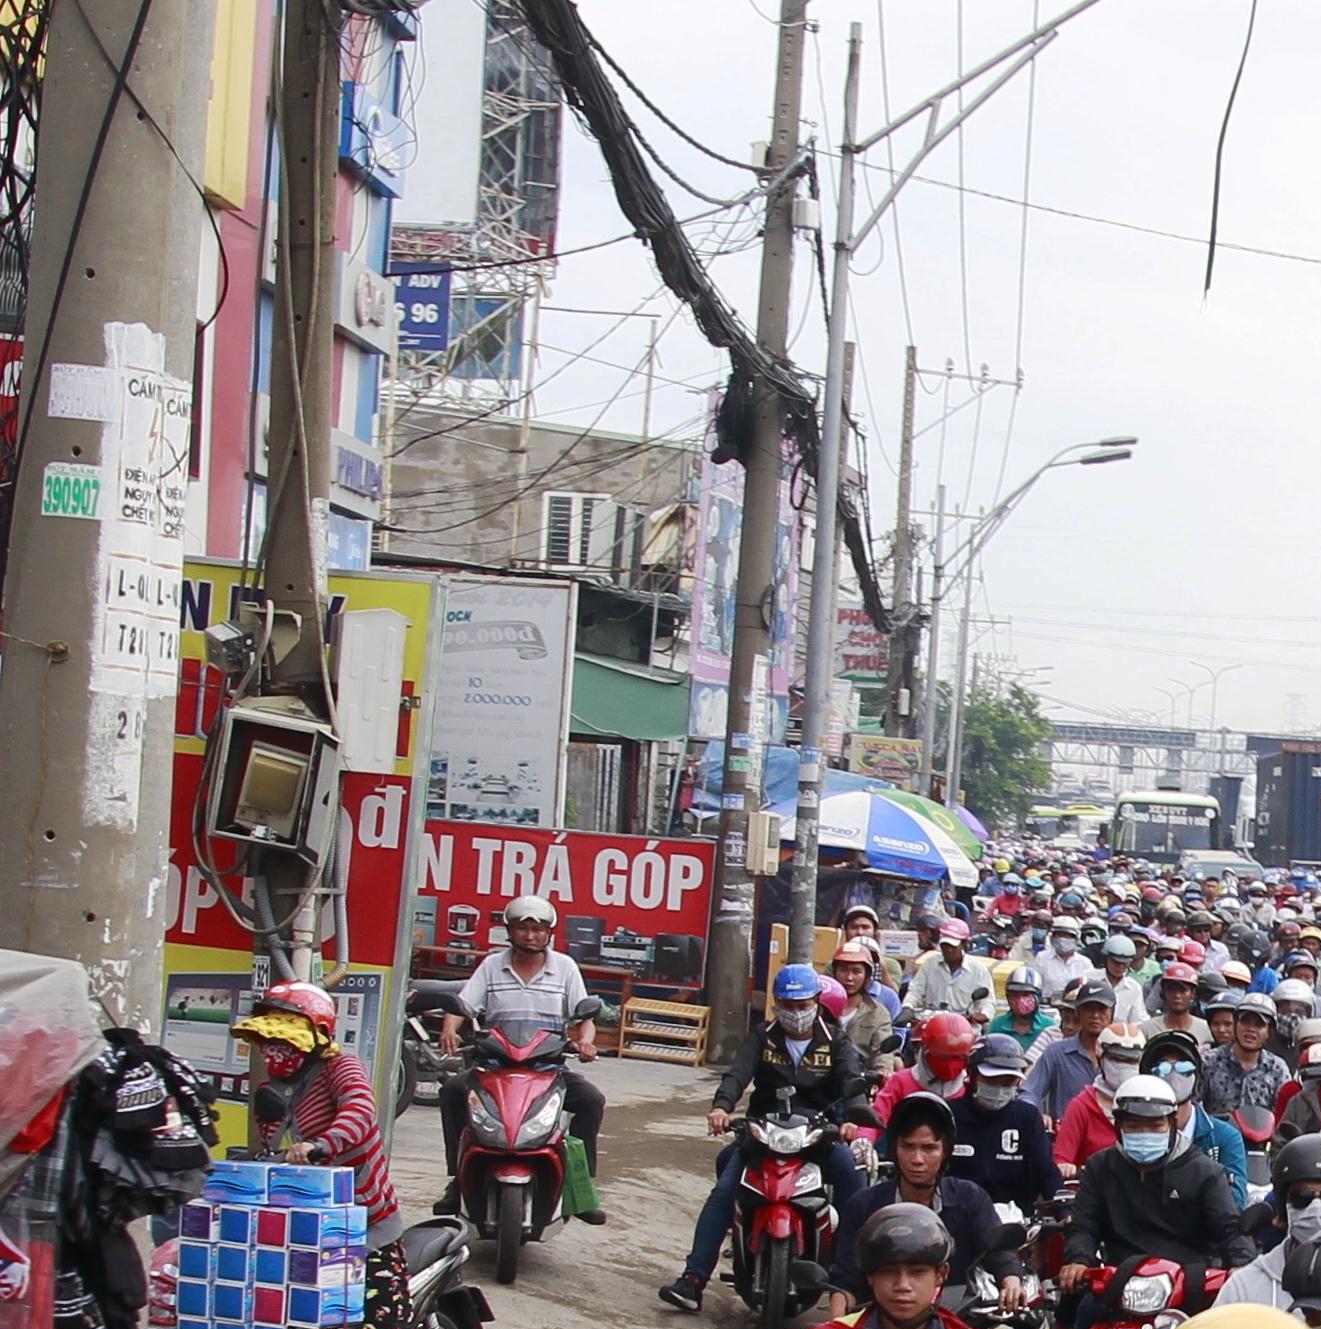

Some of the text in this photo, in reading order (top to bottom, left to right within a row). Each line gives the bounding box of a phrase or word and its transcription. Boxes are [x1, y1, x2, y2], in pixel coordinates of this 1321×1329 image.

[408, 274, 441, 289] ADV
[410, 303, 439, 324] 96
[592, 841, 704, 912] GÓP
[1001, 1129, 1019, 1153] C
